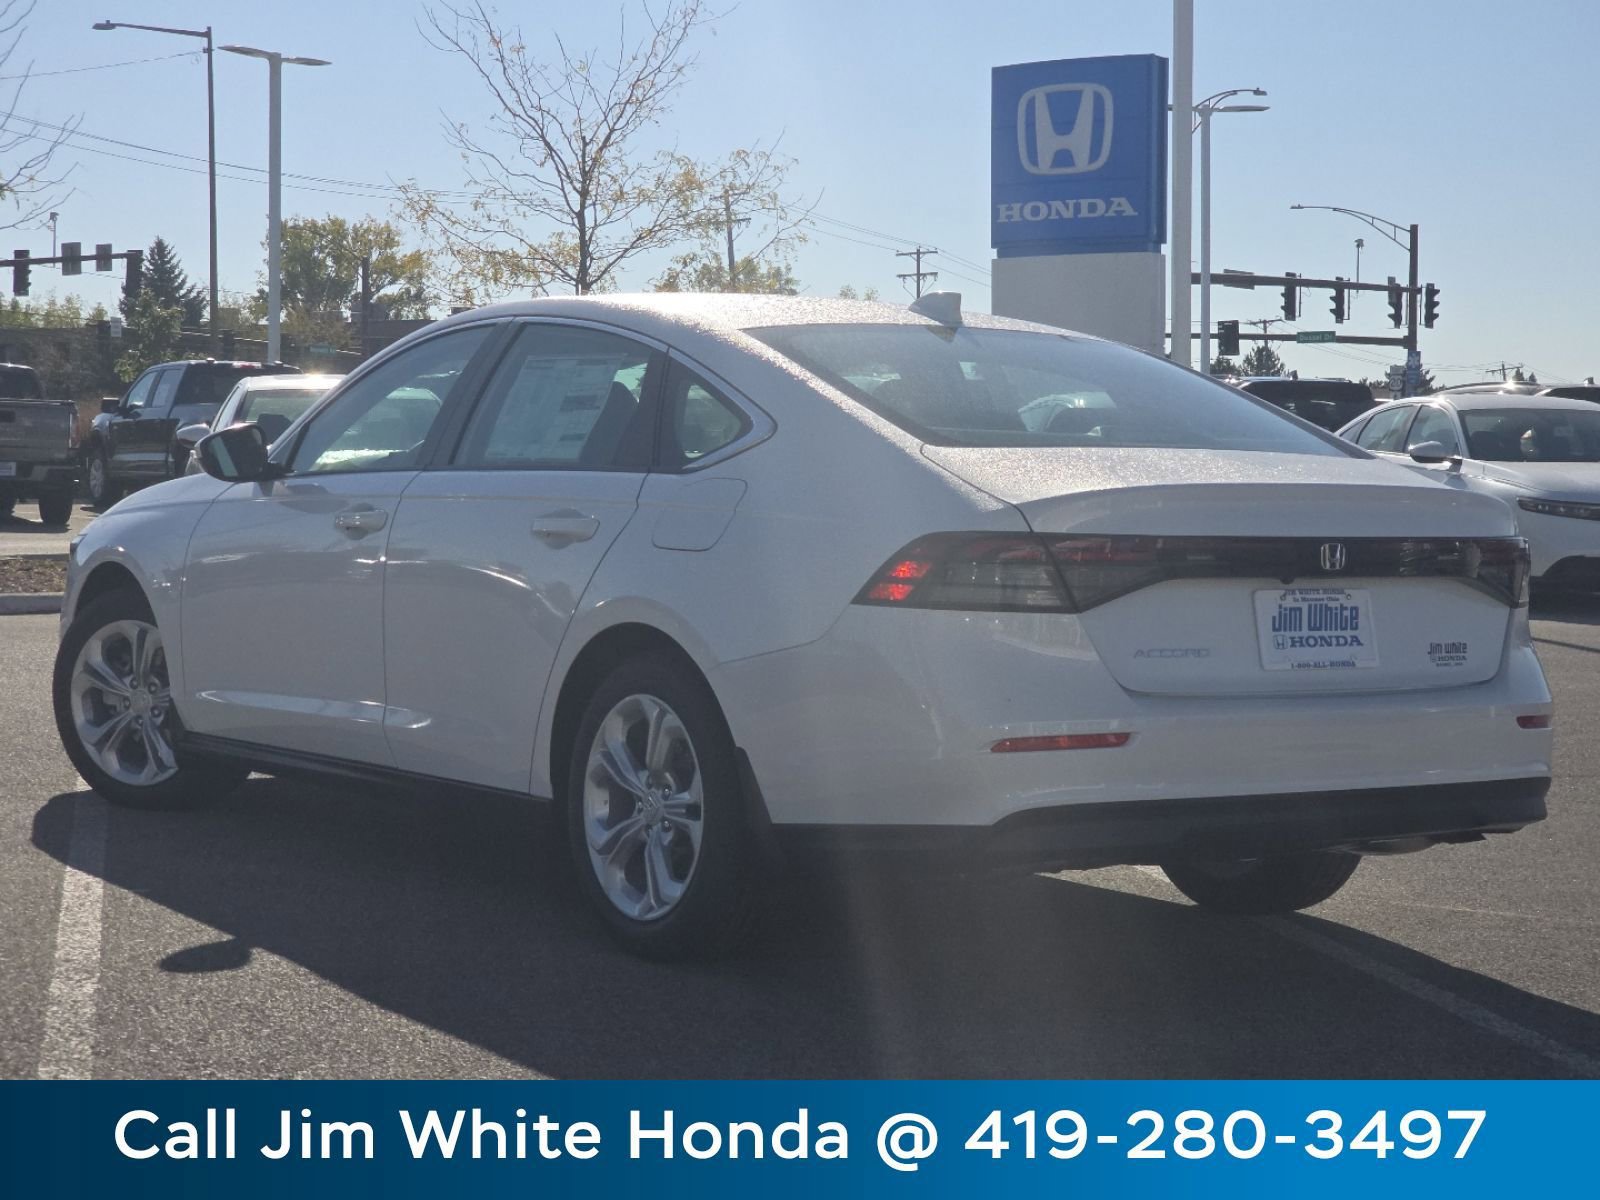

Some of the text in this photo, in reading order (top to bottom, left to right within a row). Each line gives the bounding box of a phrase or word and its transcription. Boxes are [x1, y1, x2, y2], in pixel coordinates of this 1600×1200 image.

[997, 197, 1138, 222] HONDA
[1272, 603, 1359, 633] Jim White
[1288, 635, 1364, 649] HONDA
[1133, 648, 1210, 659] ACCORD
